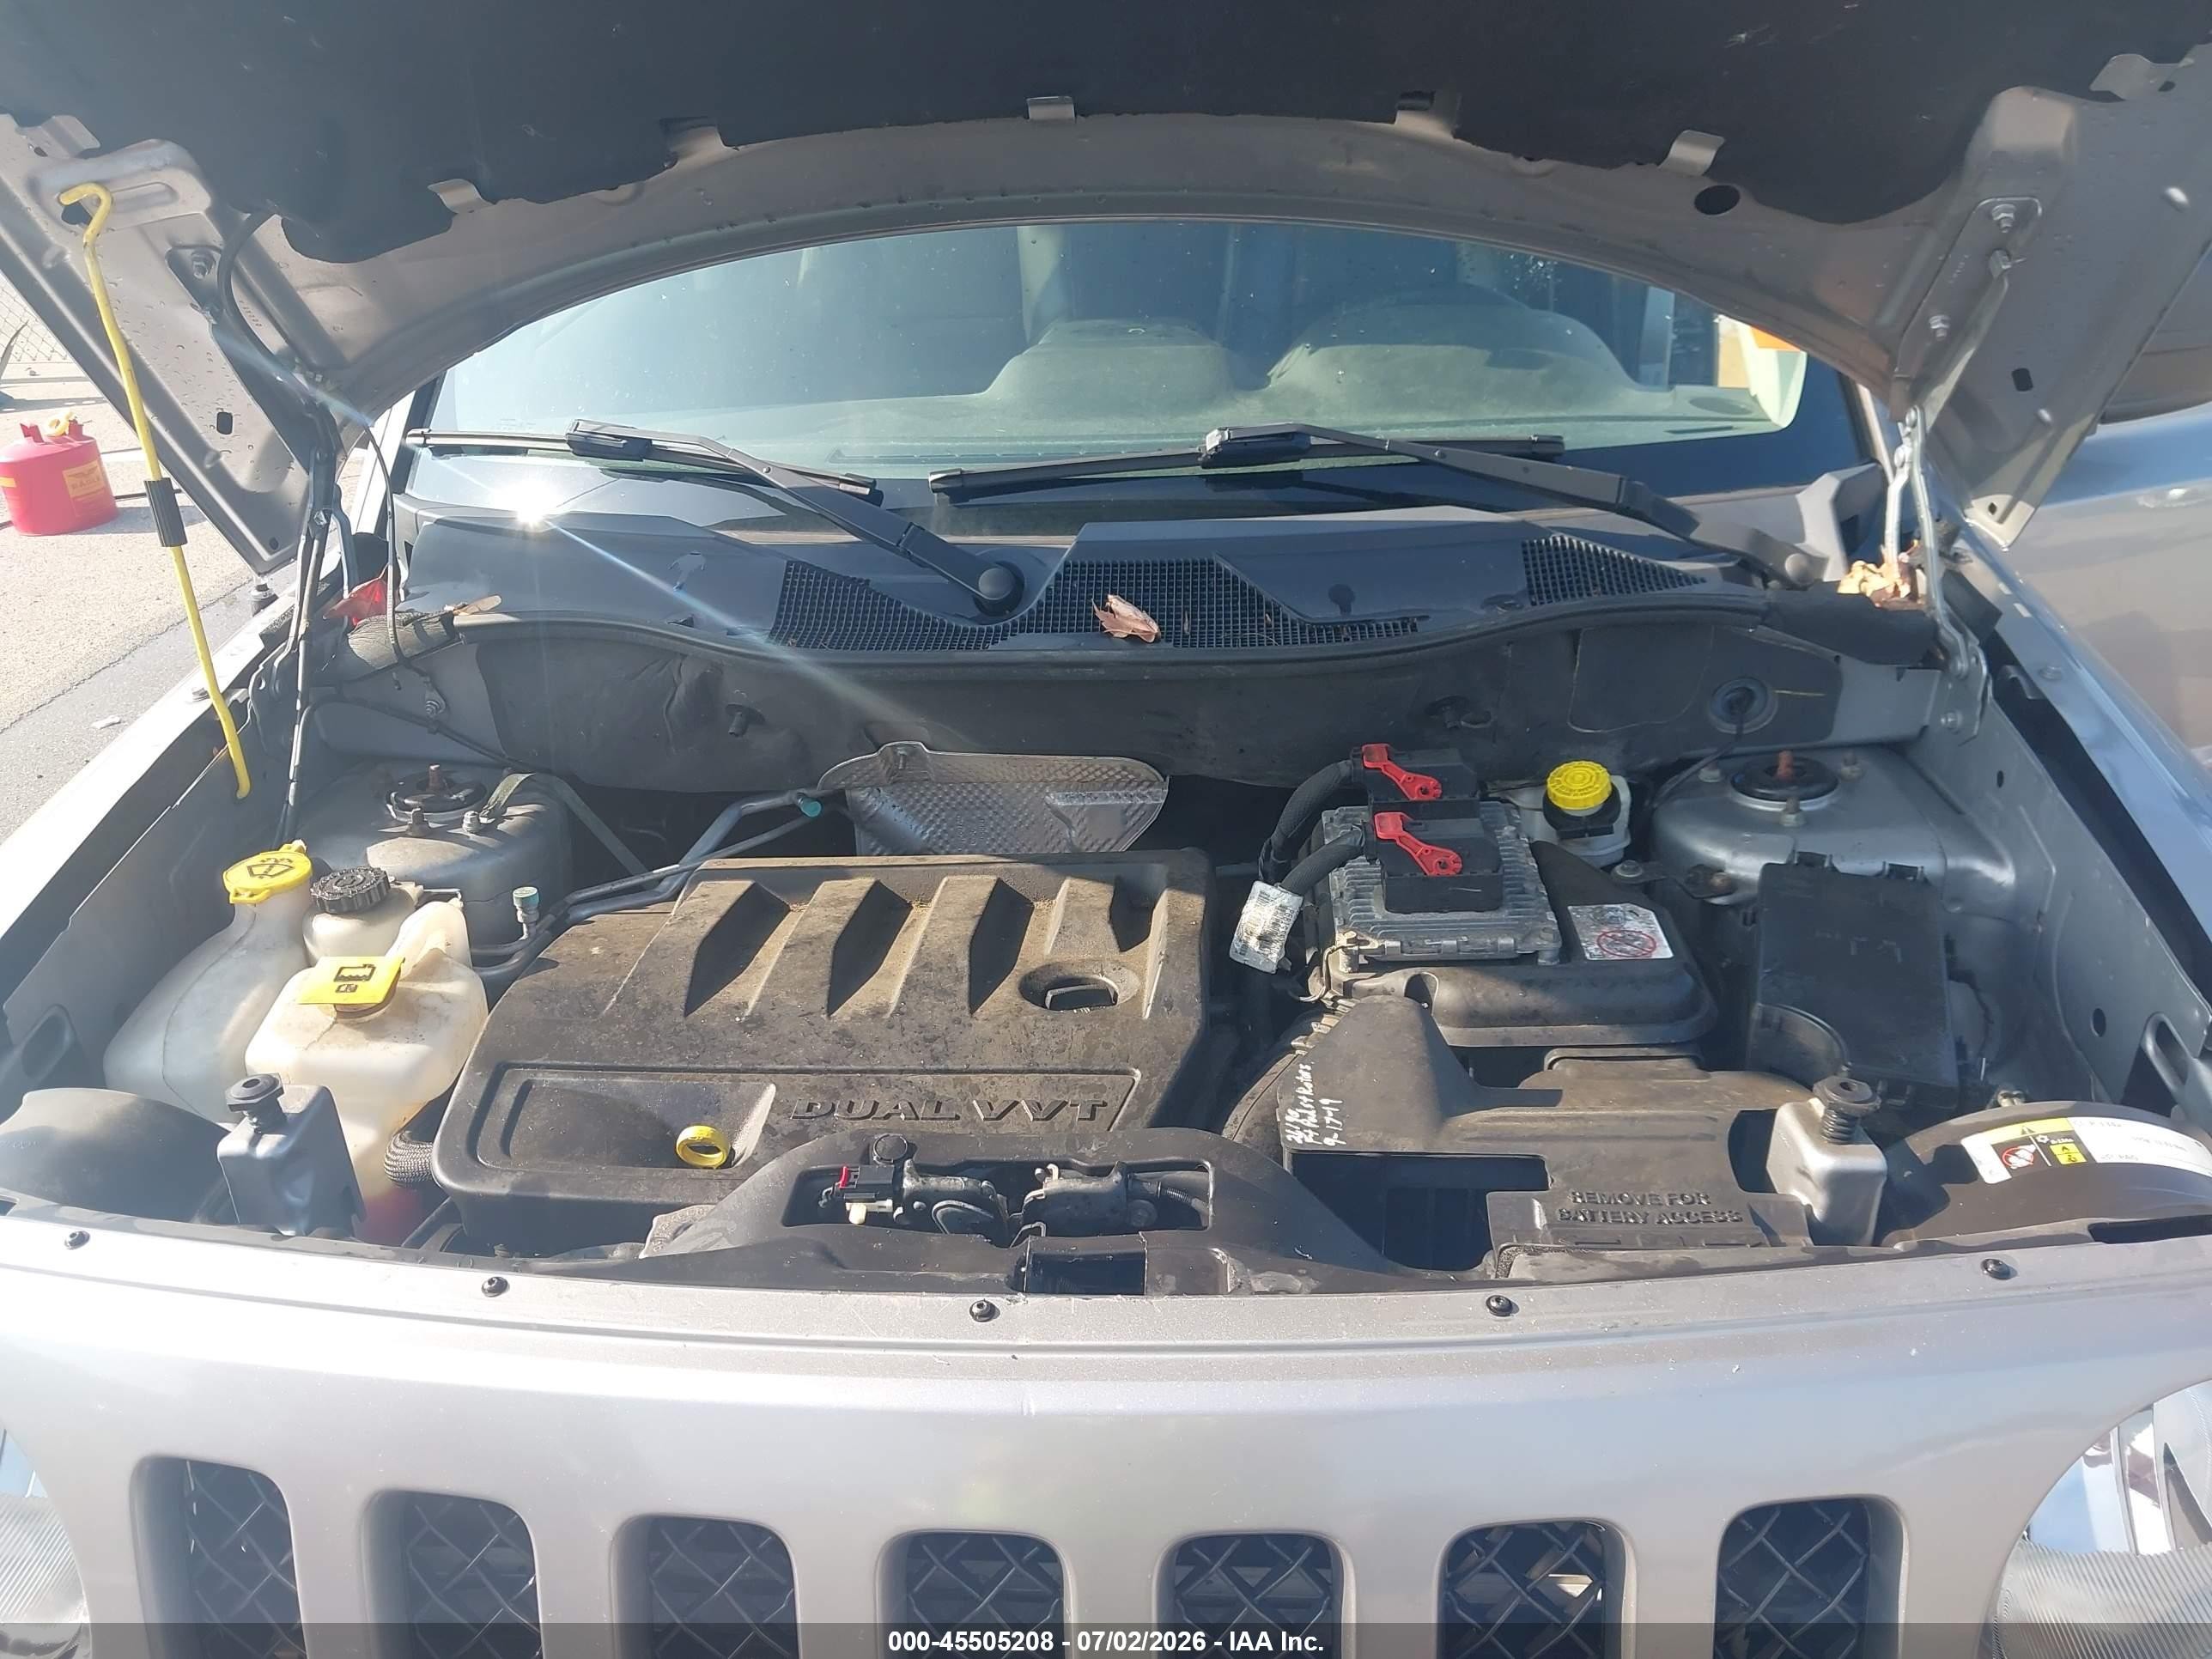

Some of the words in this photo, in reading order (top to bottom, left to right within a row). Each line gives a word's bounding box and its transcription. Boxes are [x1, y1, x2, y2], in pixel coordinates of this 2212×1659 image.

[789, 1098, 961, 1121] DUAL
[972, 1098, 1109, 1121] VVT
[1571, 1191, 1663, 1206] REMOVE
[1666, 1192, 1711, 1206] FOR
[1559, 1207, 1650, 1224] BATTERY
[1656, 1209, 1743, 1225] ACCESS
